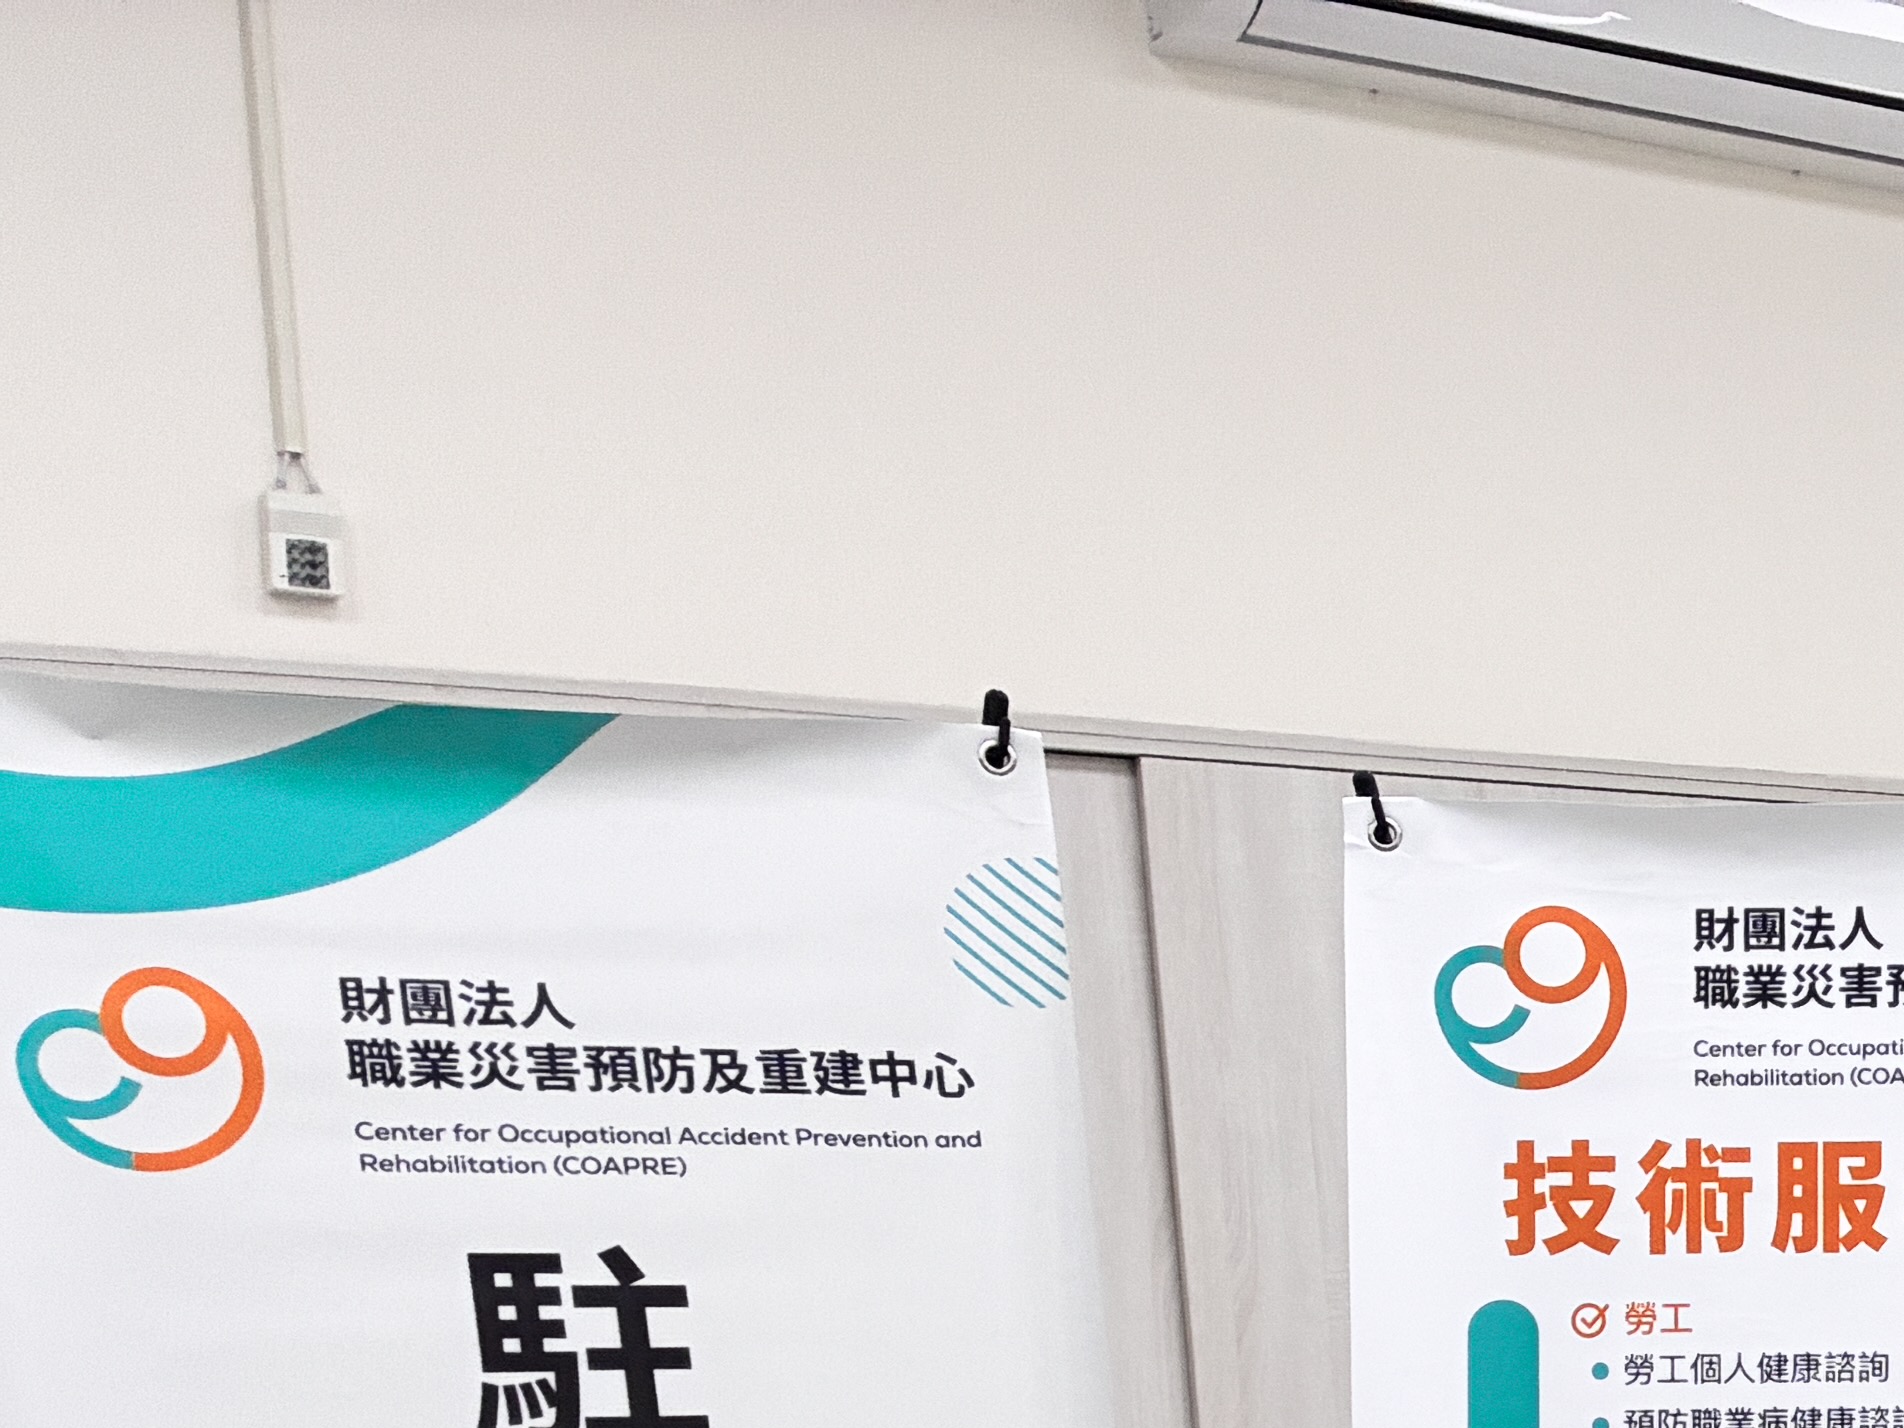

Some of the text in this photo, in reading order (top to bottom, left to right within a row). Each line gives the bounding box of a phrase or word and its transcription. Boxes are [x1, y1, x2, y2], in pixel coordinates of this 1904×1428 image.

[1693, 904, 1886, 955] 財團法人
[340, 976, 577, 1031] 財團法人
[1693, 1036, 1768, 1061] Center
[1771, 1036, 1804, 1061] for
[344, 1038, 975, 1101] 職業災害預防及重建中心
[1693, 1065, 1845, 1091] Rehabilitation
[355, 1120, 982, 1154] Center for Occupational Accident Prevention and
[359, 1151, 688, 1183] Rehabilitation (COAPRE)
[1624, 1300, 1694, 1336] 勞工
[1622, 1350, 1891, 1388] 勞工個人健康諮詢
